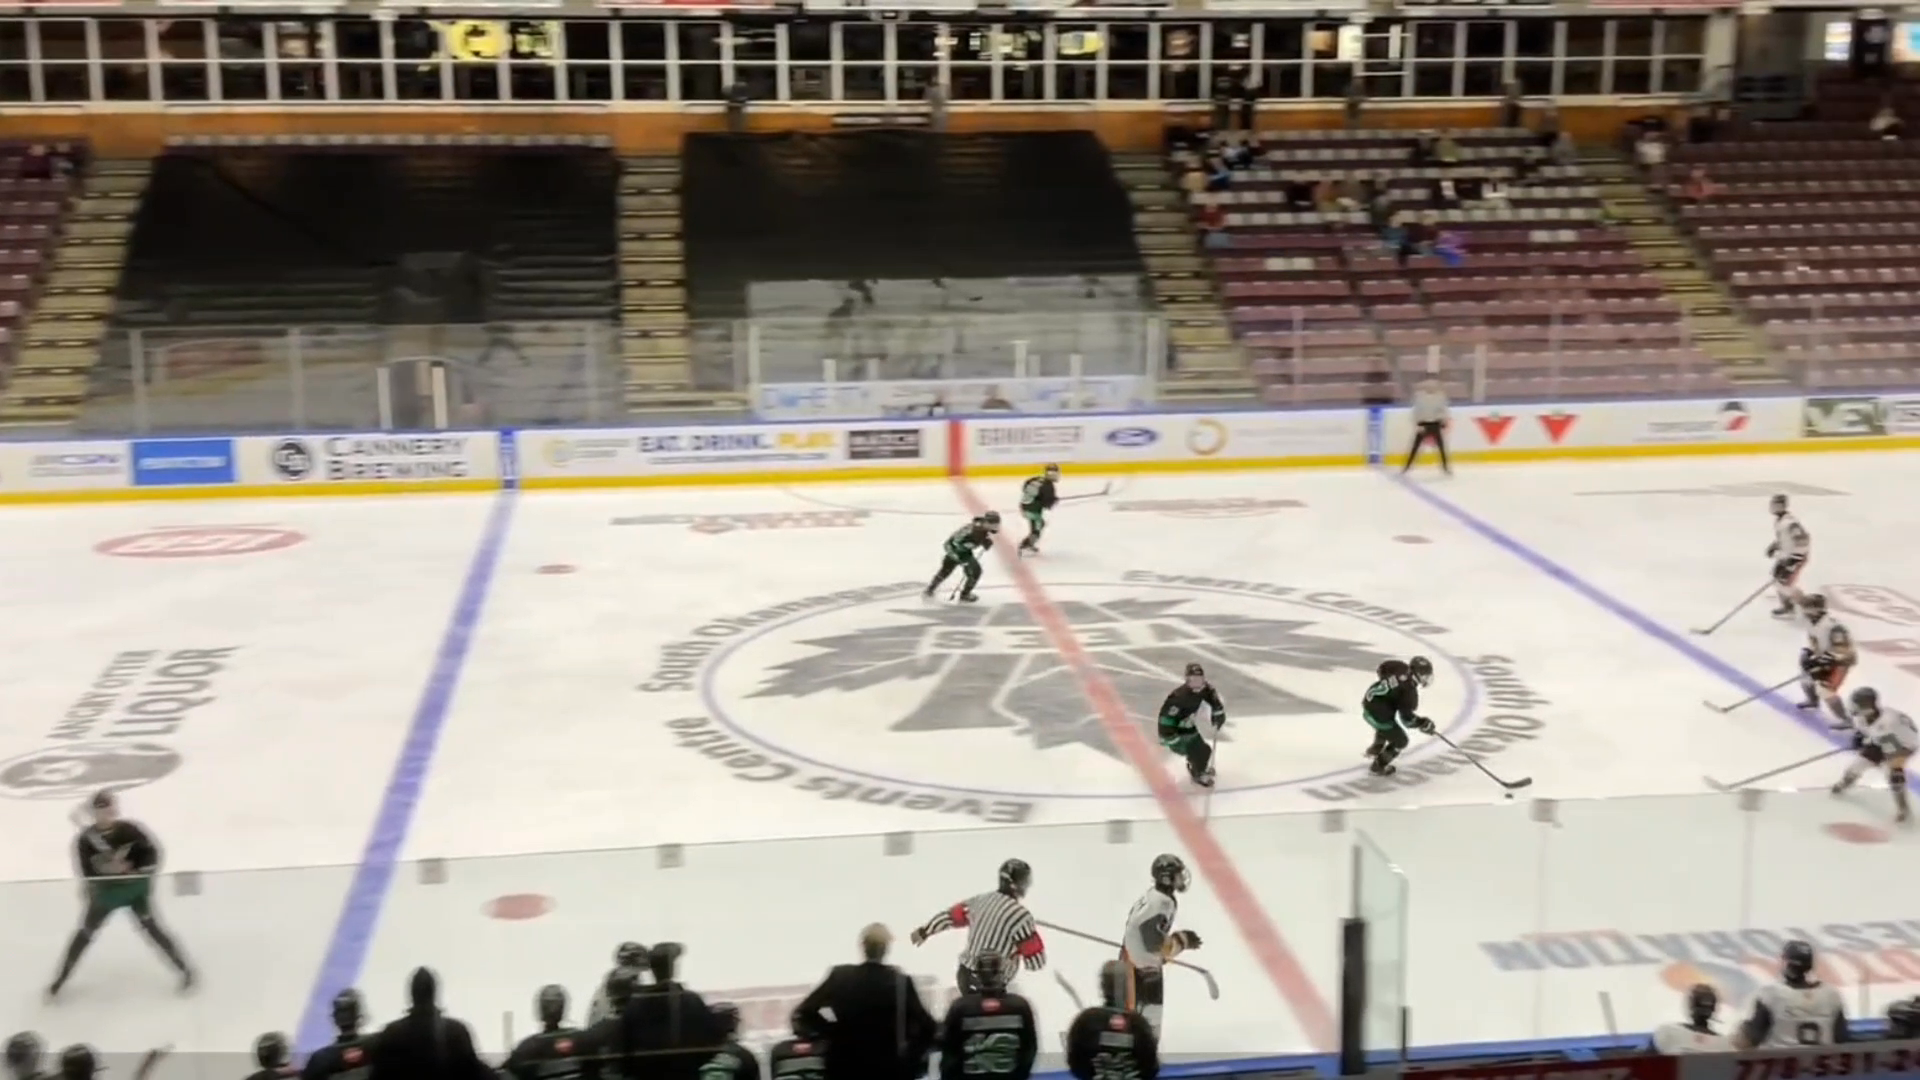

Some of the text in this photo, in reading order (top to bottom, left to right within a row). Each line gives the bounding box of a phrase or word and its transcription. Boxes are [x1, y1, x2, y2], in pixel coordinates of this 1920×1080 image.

[101, 645, 244, 738] LIQUOR
[665, 717, 1033, 823] Events Centre
[1479, 920, 1920, 971] ESTORATION
